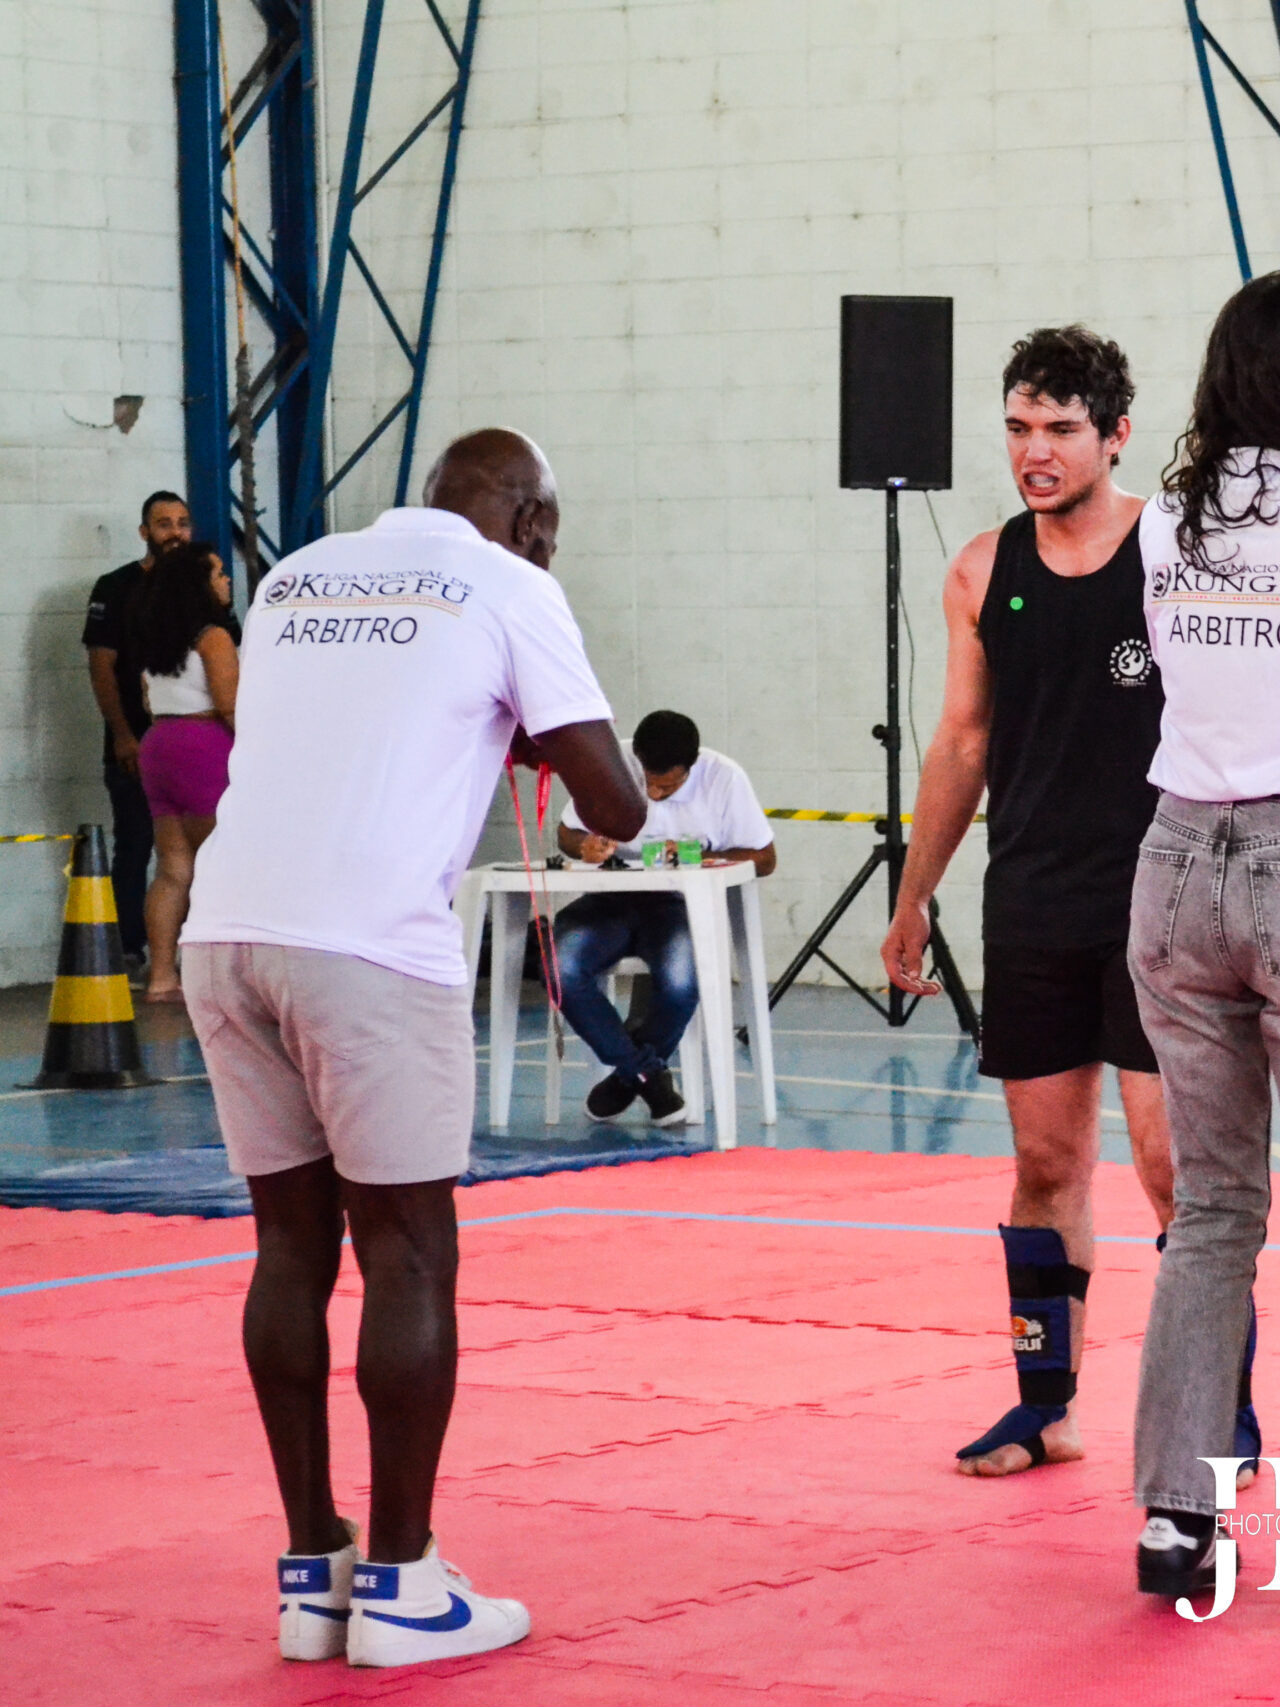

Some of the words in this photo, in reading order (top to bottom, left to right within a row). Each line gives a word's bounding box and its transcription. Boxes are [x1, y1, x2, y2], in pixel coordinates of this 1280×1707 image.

[364, 569, 446, 582] NACIONAL
[1172, 562, 1277, 594] KUNG
[294, 573, 407, 598] KUNG
[415, 578, 471, 605] FU
[275, 611, 418, 647] ÁRBITRO
[1013, 1337, 1042, 1351] GUI
[282, 1569, 310, 1584] NIKE
